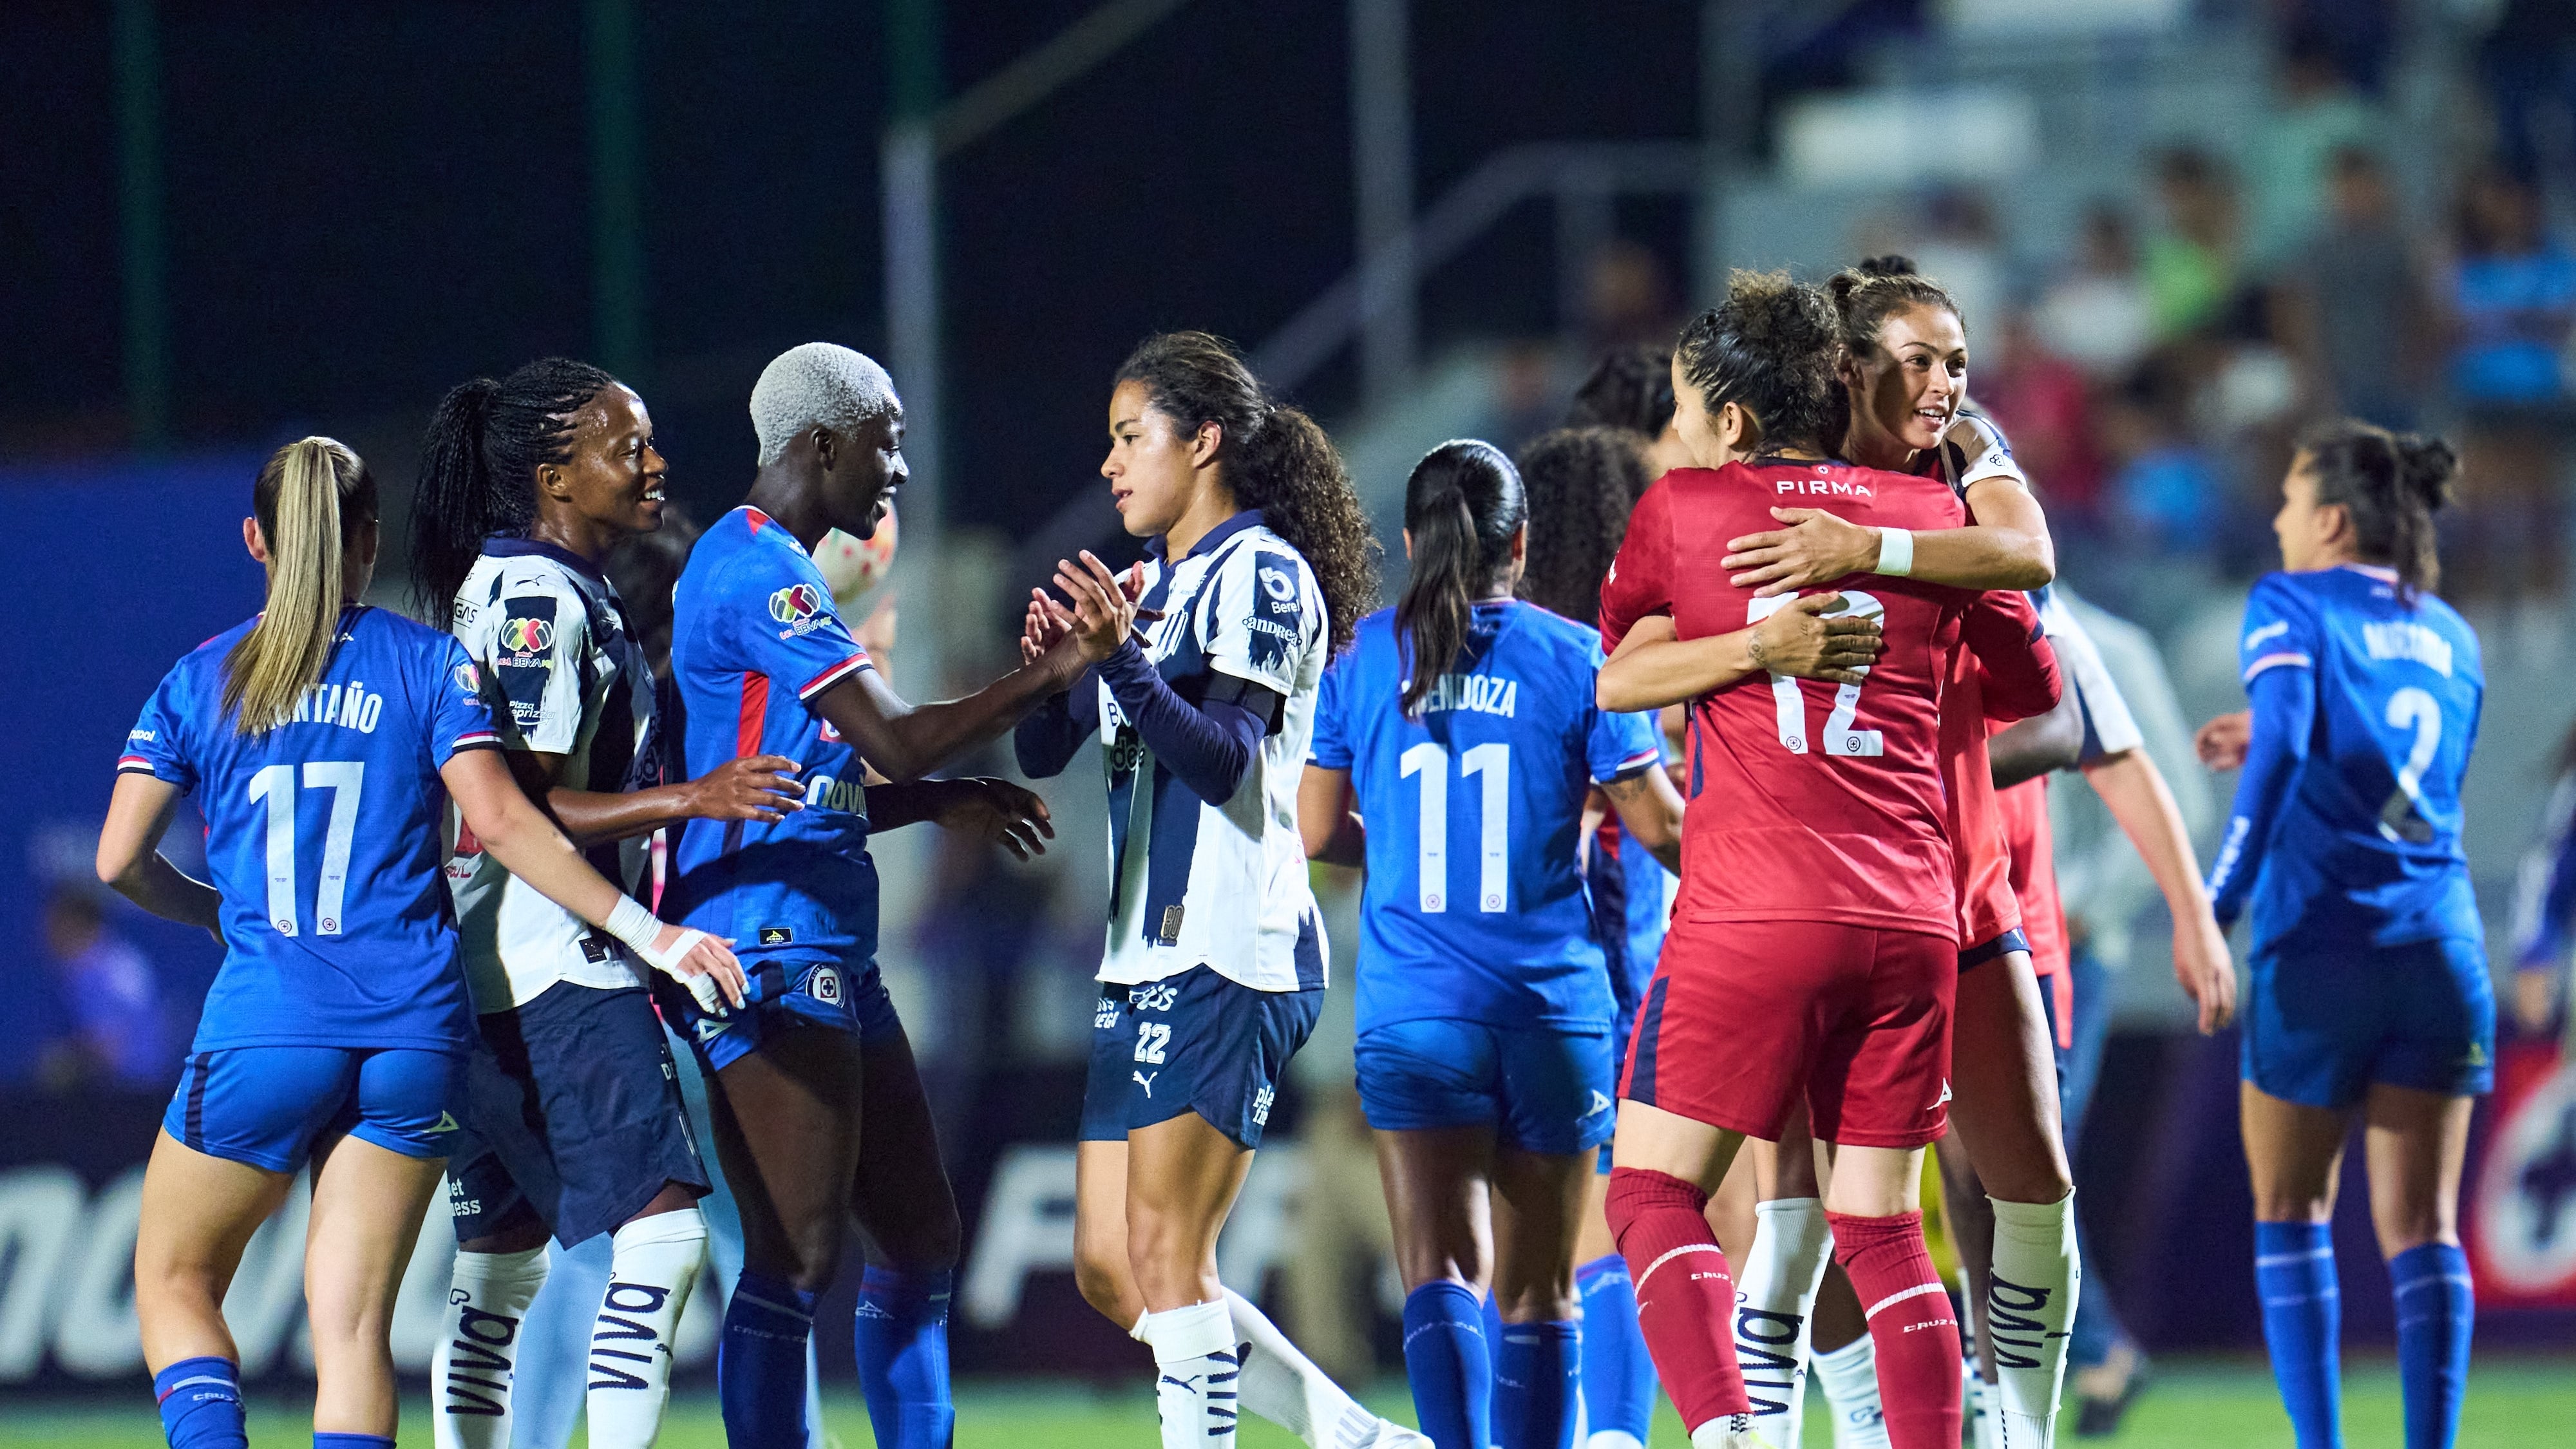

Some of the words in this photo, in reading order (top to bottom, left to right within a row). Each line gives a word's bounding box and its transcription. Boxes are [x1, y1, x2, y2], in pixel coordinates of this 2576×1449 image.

[1776, 480, 1873, 498] PIRMA
[794, 619, 822, 636] BBVA
[1271, 599, 1300, 614] Berel
[513, 658, 541, 668] BBVA
[252, 680, 383, 734] ONTAÑO
[509, 701, 535, 709] Pizza
[2378, 687, 2443, 842] 2
[1400, 742, 1510, 913] 11
[250, 761, 365, 938] 17
[1134, 1022, 1171, 1064] 22
[1690, 1271, 1729, 1281] CRUZ
[589, 1282, 670, 1391] viva
[1904, 1319, 1947, 1333] CRUZ
[1988, 1271, 2052, 1368] viva
[446, 1305, 519, 1417] viva
